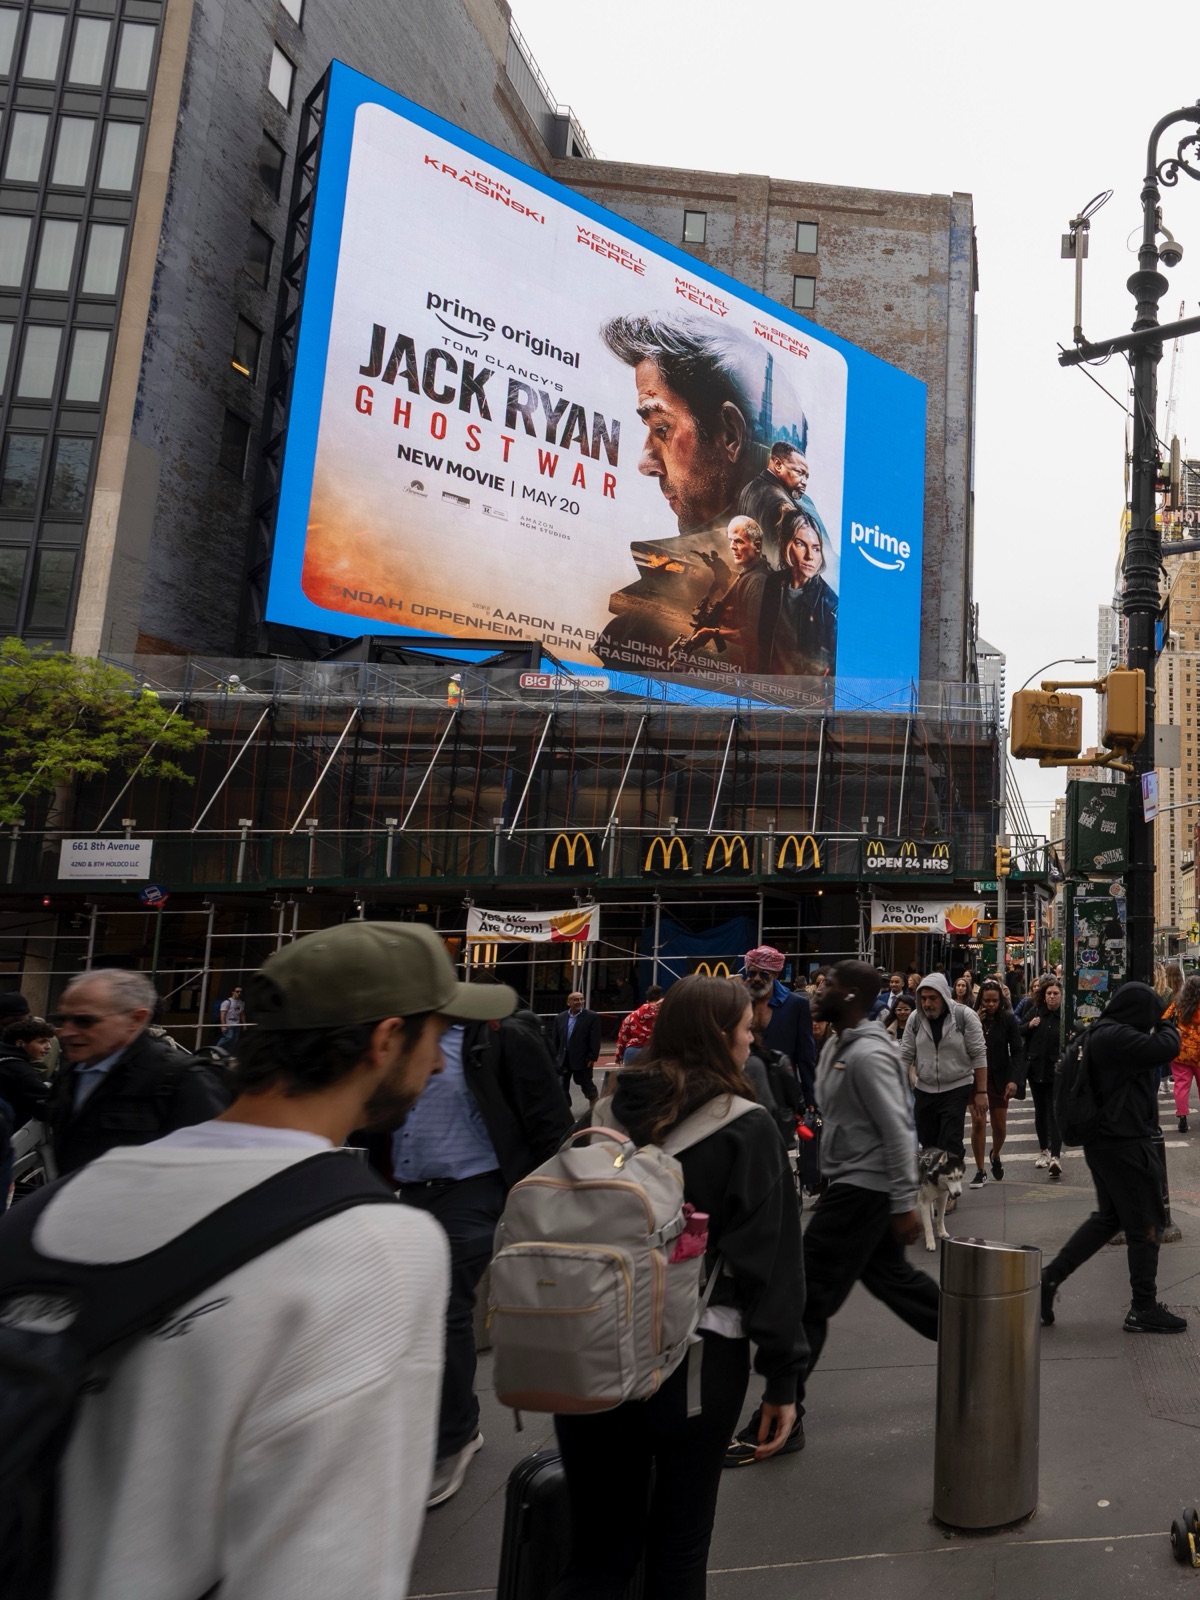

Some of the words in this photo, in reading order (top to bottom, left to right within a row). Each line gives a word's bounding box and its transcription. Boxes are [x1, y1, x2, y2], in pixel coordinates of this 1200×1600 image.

[424, 154, 545, 225] KRASINSKI
[464, 169, 511, 196] JOHN
[576, 224, 647, 267] WENDELL
[577, 235, 645, 276] PIERCE
[675, 277, 730, 311] MICHAEL
[675, 286, 728, 317] KELLY
[426, 291, 496, 332] prime
[501, 325, 580, 369] original
[752, 320, 769, 331] AND
[770, 327, 811, 353] SIENNA
[754, 326, 809, 360] MILLER
[441, 336, 478, 358] TOM
[485, 354, 564, 392] CLANCY'S
[359, 322, 496, 422] JACK
[504, 377, 621, 468] RYAN
[355, 384, 515, 463] GHOST
[537, 448, 618, 500] WAR
[397, 443, 444, 472] NEW
[446, 459, 505, 492] MOVIE
[522, 484, 557, 508] MAY
[559, 497, 580, 516] 20
[520, 515, 554, 530] AMAZON
[520, 521, 537, 532] MGM
[539, 527, 571, 541] STUDIOS
[850, 521, 911, 559] prime
[342, 587, 403, 611] NOAH
[410, 603, 523, 638] OPPENHEIM
[534, 633, 582, 652] JOHN
[587, 640, 671, 671] KRASINSKI
[492, 608, 555, 632] AARON
[561, 624, 611, 645] RABIN
[621, 639, 663, 657] JOHN
[668, 650, 742, 675] KRASINSKI
[524, 675, 547, 687] BIG
[552, 677, 605, 690] OUTDOOR
[687, 667, 748, 689] ANDREW
[752, 681, 824, 704] BERNSTEIN
[72, 842, 88, 851] 661
[90, 841, 105, 851] 8th
[107, 841, 140, 851] Avenue
[867, 857, 902, 868] OPEN
[905, 857, 921, 869] 24
[922, 858, 949, 870] HRS
[480, 911, 505, 923] Yes,
[881, 903, 905, 915] Yes,
[906, 904, 924, 913] We
[881, 914, 902, 923] Are
[904, 914, 938, 926] Open!
[478, 922, 500, 932] Are
[503, 923, 543, 935] Open!
